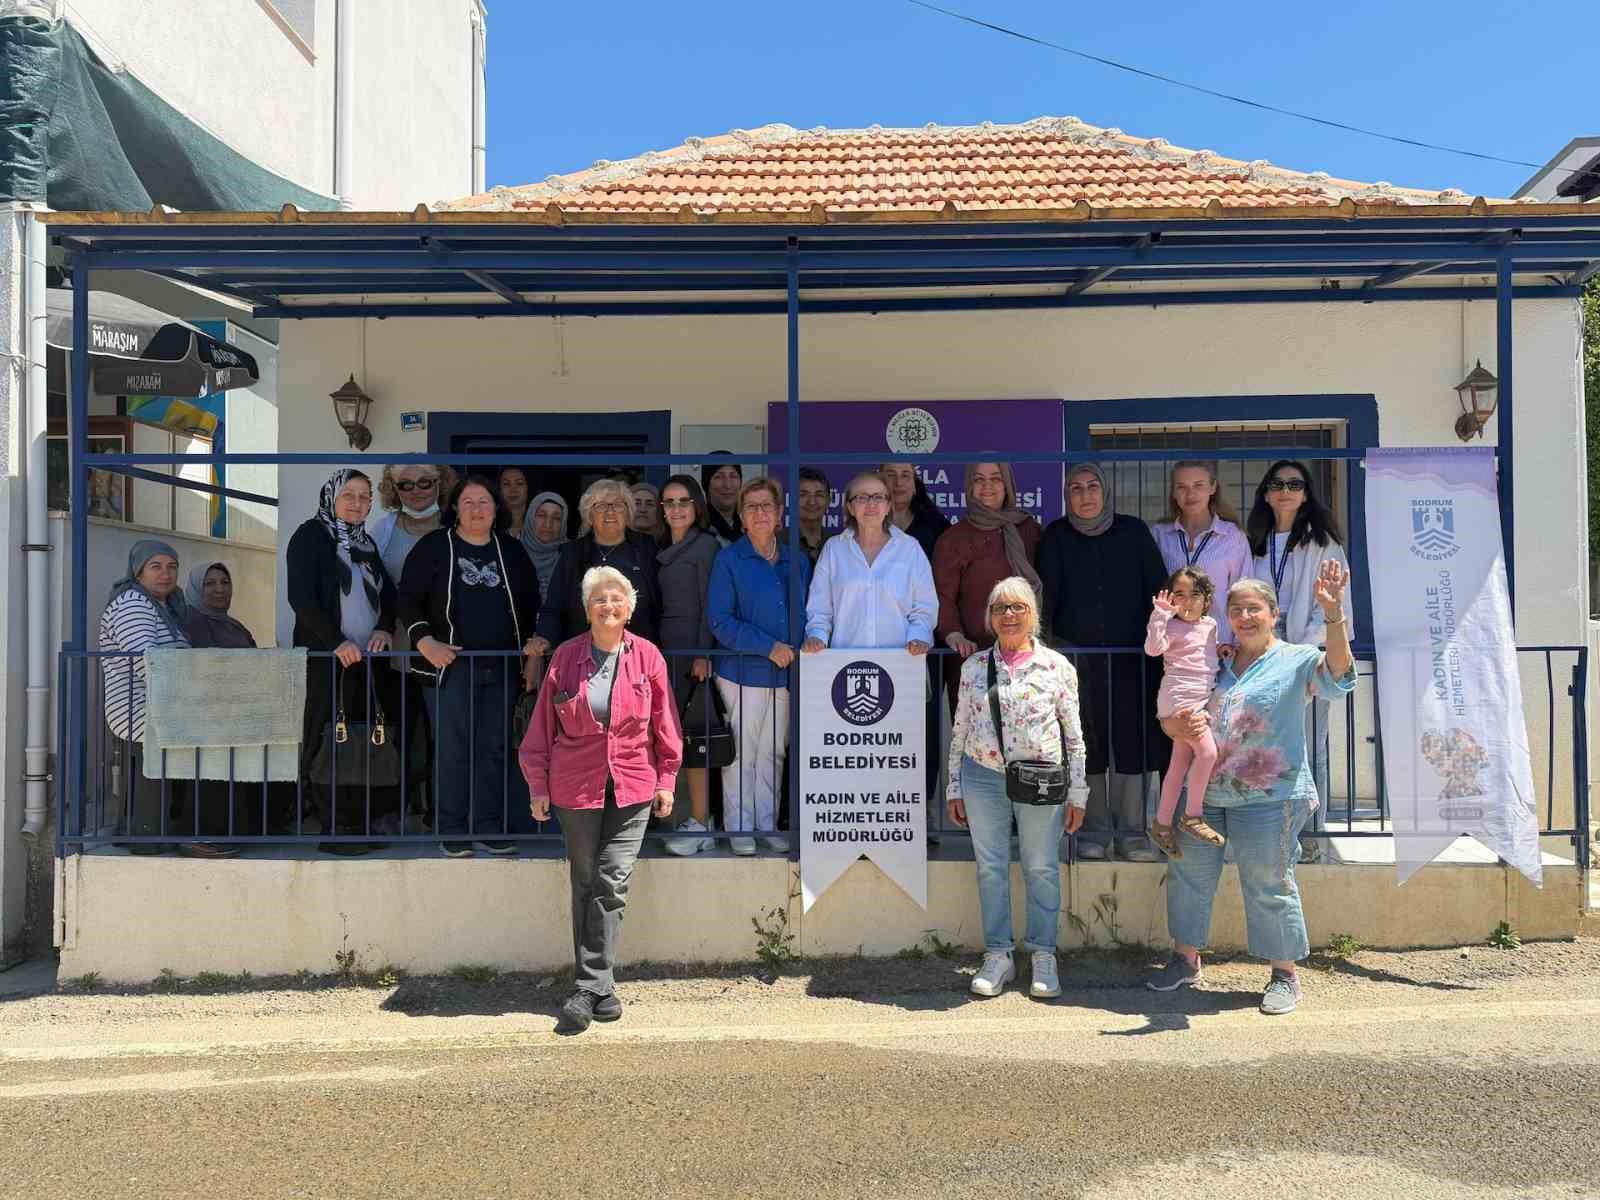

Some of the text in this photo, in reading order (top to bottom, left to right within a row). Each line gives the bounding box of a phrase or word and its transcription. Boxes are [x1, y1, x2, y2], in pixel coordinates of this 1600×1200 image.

[1424, 586, 1449, 700] KADIN VE AİLE
[1448, 648, 1465, 716] HİZMETLERİ
[843, 707, 884, 722] BELEDİYESİ
[823, 732, 903, 746] BODRUM
[809, 752, 917, 769] BELEDİYESİ
[805, 790, 920, 805] KADIN VE AİLE
[815, 809, 910, 824] HİZMETLERİ
[812, 828, 914, 842] MÜDÜRLÜĞÜ
